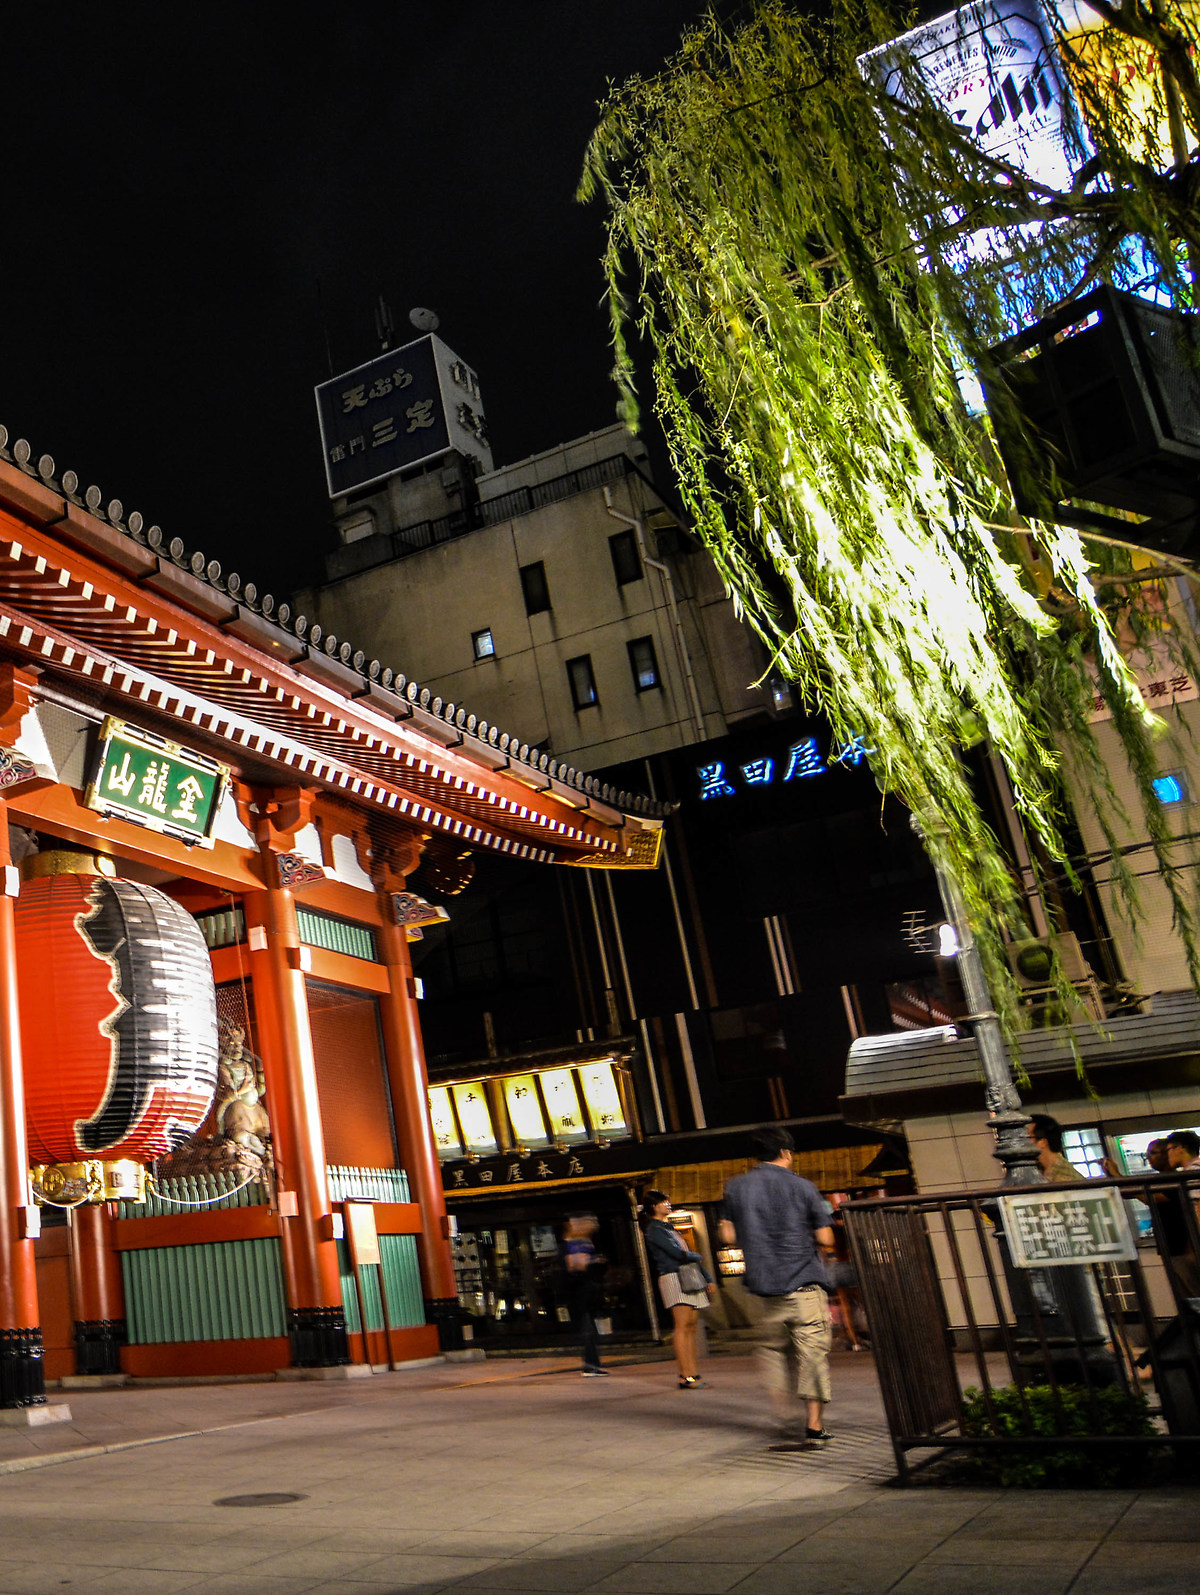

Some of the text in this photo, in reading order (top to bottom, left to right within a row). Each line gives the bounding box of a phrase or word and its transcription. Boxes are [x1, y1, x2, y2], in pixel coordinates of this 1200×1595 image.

[342, 368, 413, 414] 天ぷら
[372, 399, 436, 448] 三定
[452, 1156, 584, 1188] 黒田屋本店
[1015, 1201, 1124, 1260] 駐輪禁止
